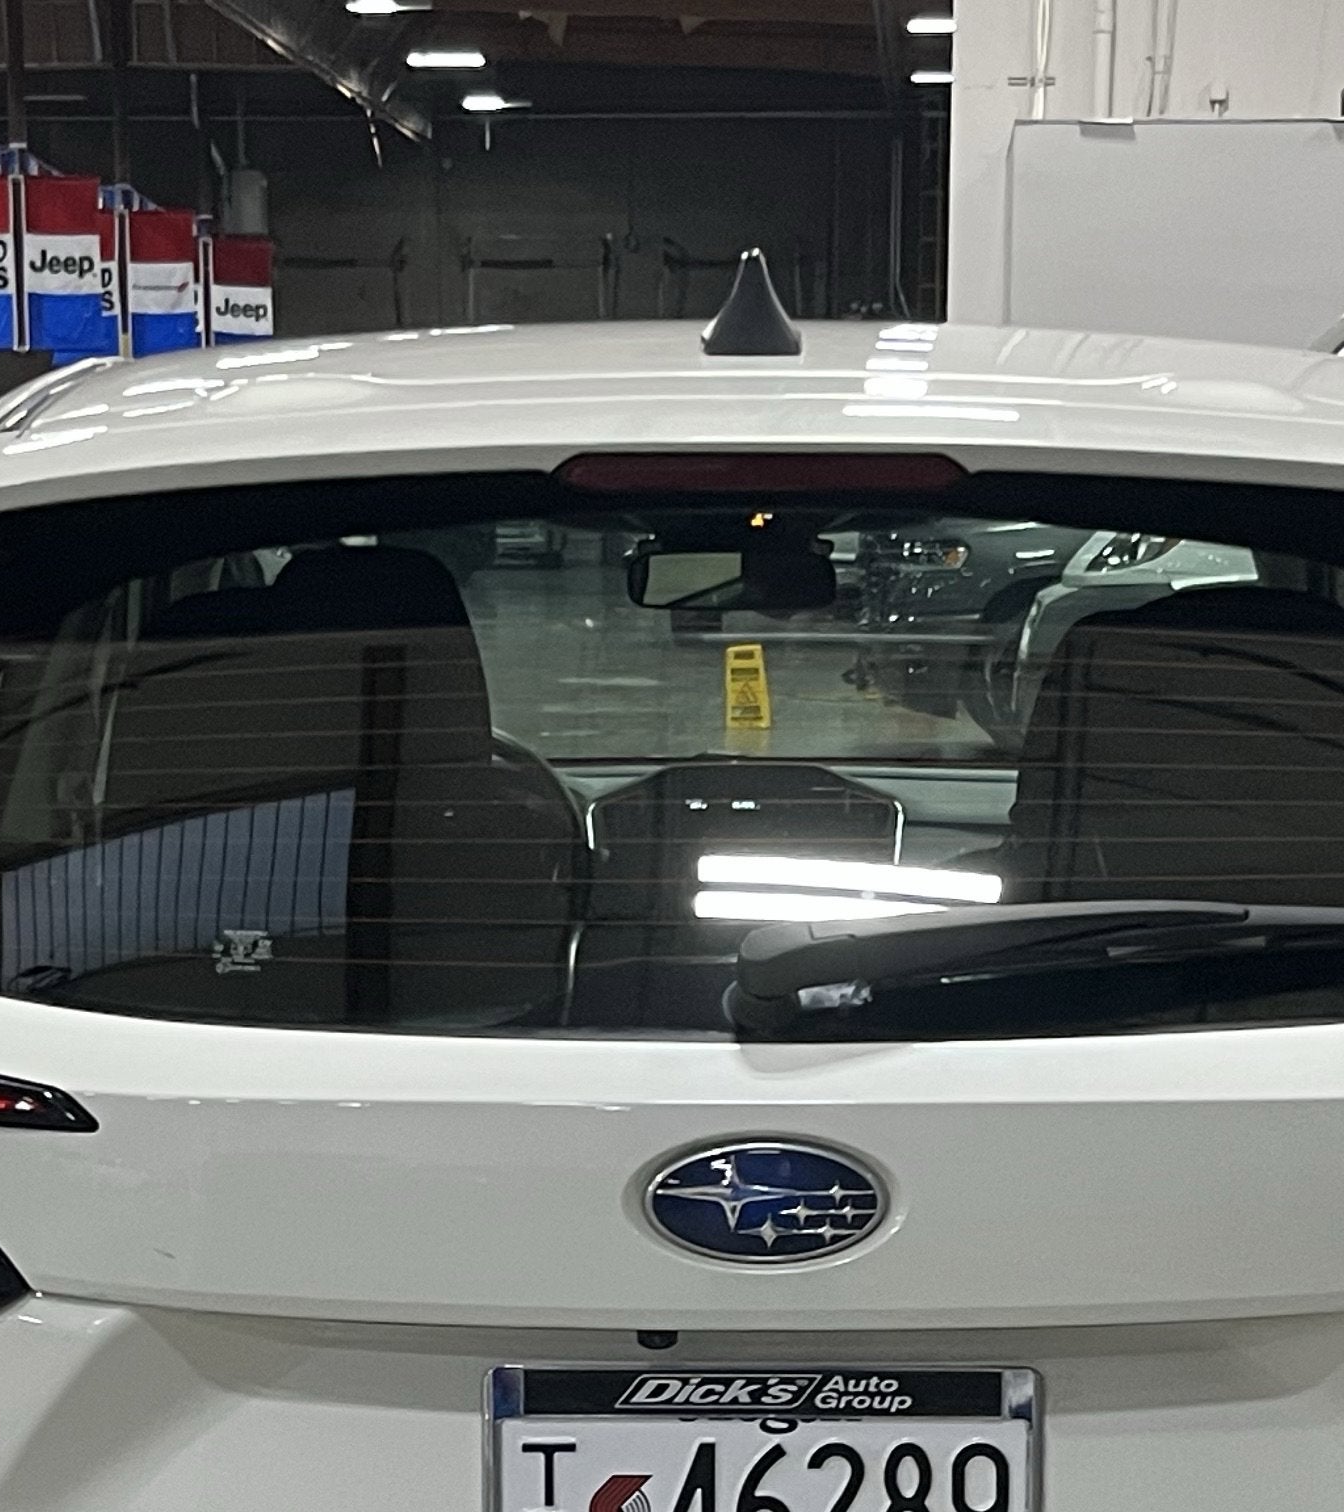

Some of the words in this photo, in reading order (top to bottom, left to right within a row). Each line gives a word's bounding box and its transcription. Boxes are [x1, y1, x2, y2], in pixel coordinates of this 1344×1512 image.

[29, 249, 95, 279] Jeep
[216, 298, 268, 322] Jeep
[630, 1377, 801, 1403] Dick's
[822, 1375, 899, 1393] Auto
[814, 1391, 913, 1413] Group
